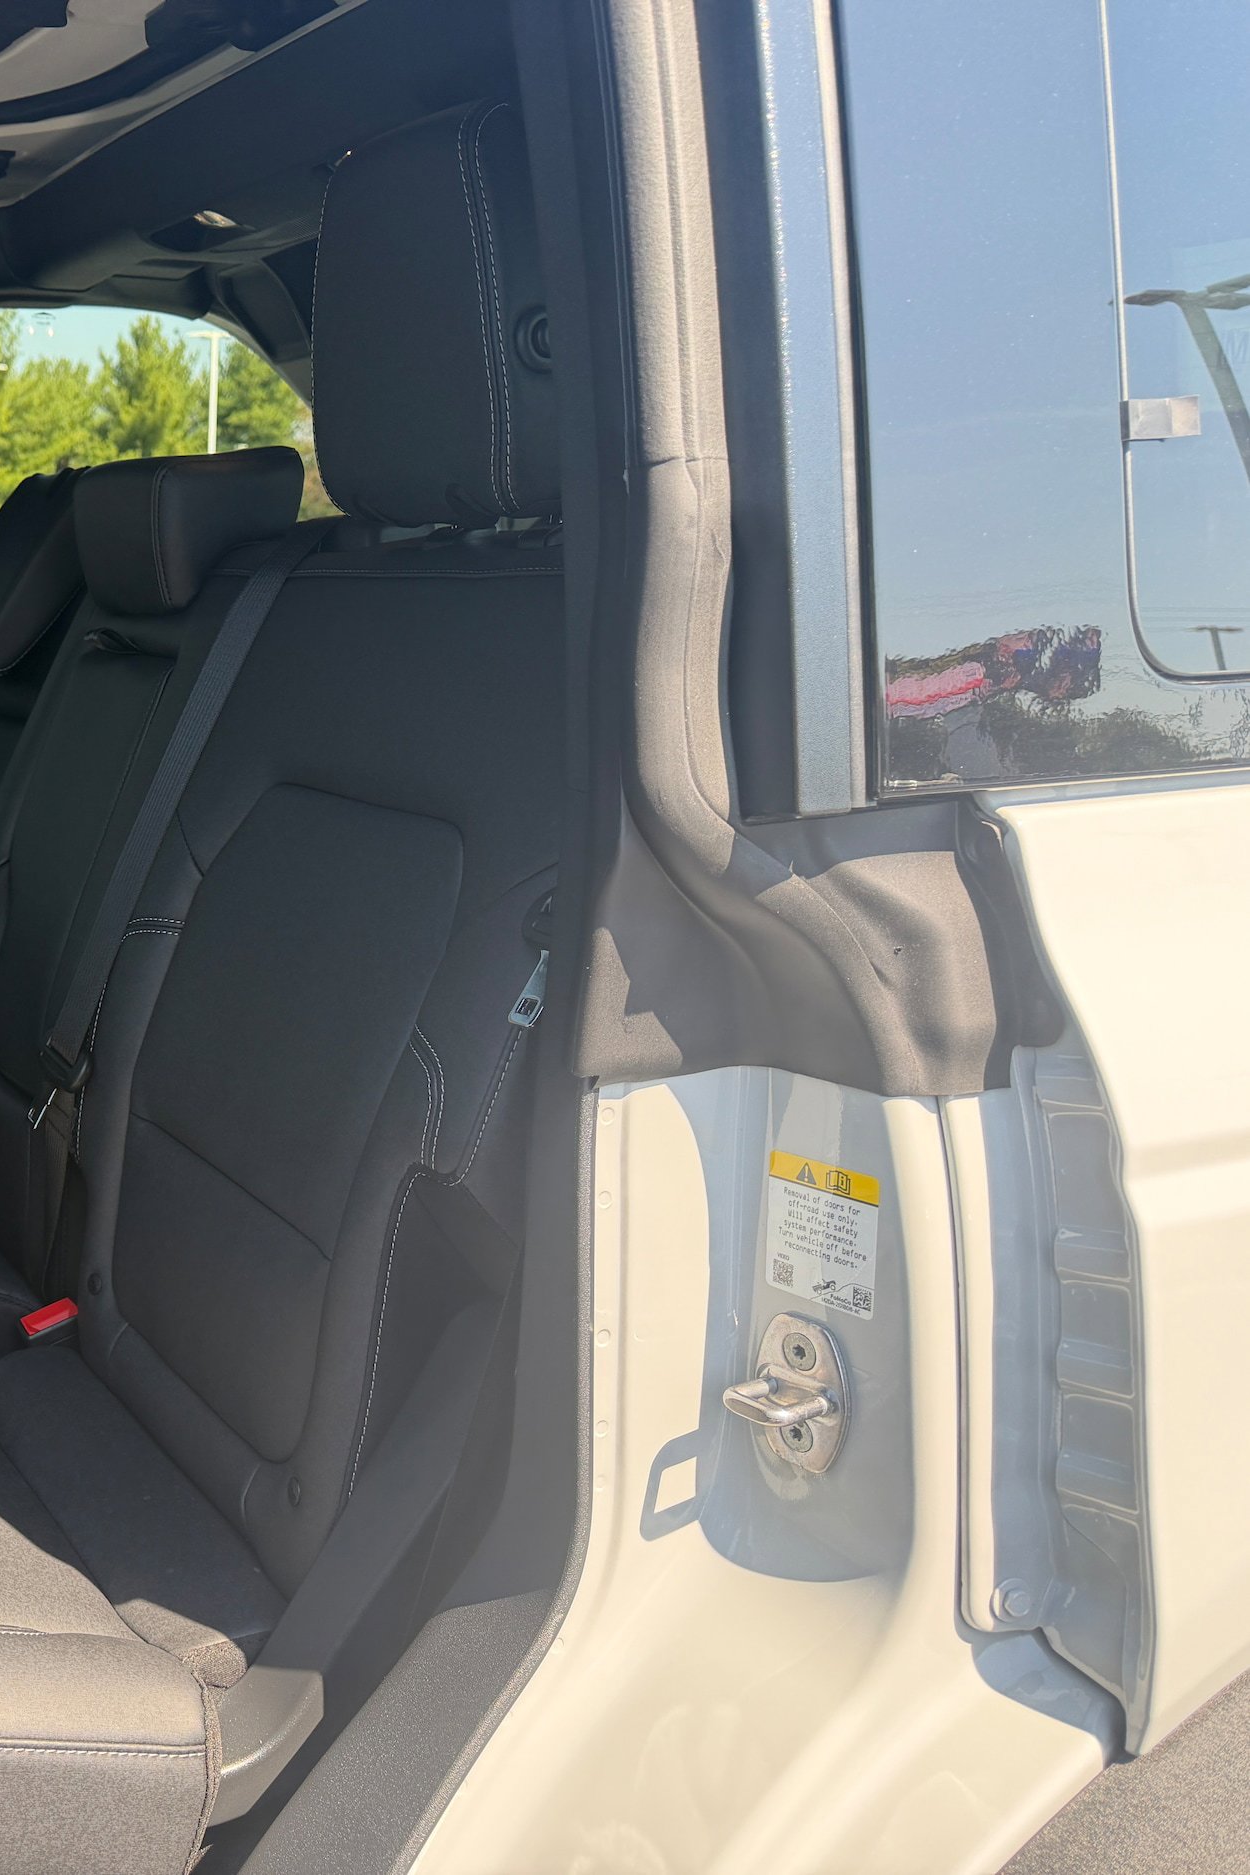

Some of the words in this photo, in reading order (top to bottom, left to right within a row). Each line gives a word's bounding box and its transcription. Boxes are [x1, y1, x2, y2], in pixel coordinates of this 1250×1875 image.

[783, 1187, 809, 1201] Removal
[812, 1195, 820, 1204] of
[824, 1199, 844, 1211] doors
[848, 1205, 860, 1216] for
[788, 1198, 818, 1214] off-road
[822, 1210, 834, 1219] use
[838, 1213, 857, 1227] only.
[784, 1219, 806, 1233] system
[809, 1226, 857, 1247] performance.
[788, 1208, 802, 1220] Will
[806, 1215, 829, 1228] affect
[833, 1223, 858, 1238] safety
[778, 1226, 793, 1238] Turn
[796, 1232, 823, 1248] vehicle
[826, 1242, 837, 1252] off
[841, 1247, 866, 1261] before
[784, 1240, 830, 1262] reconnecting
[833, 1255, 857, 1269] doors.
